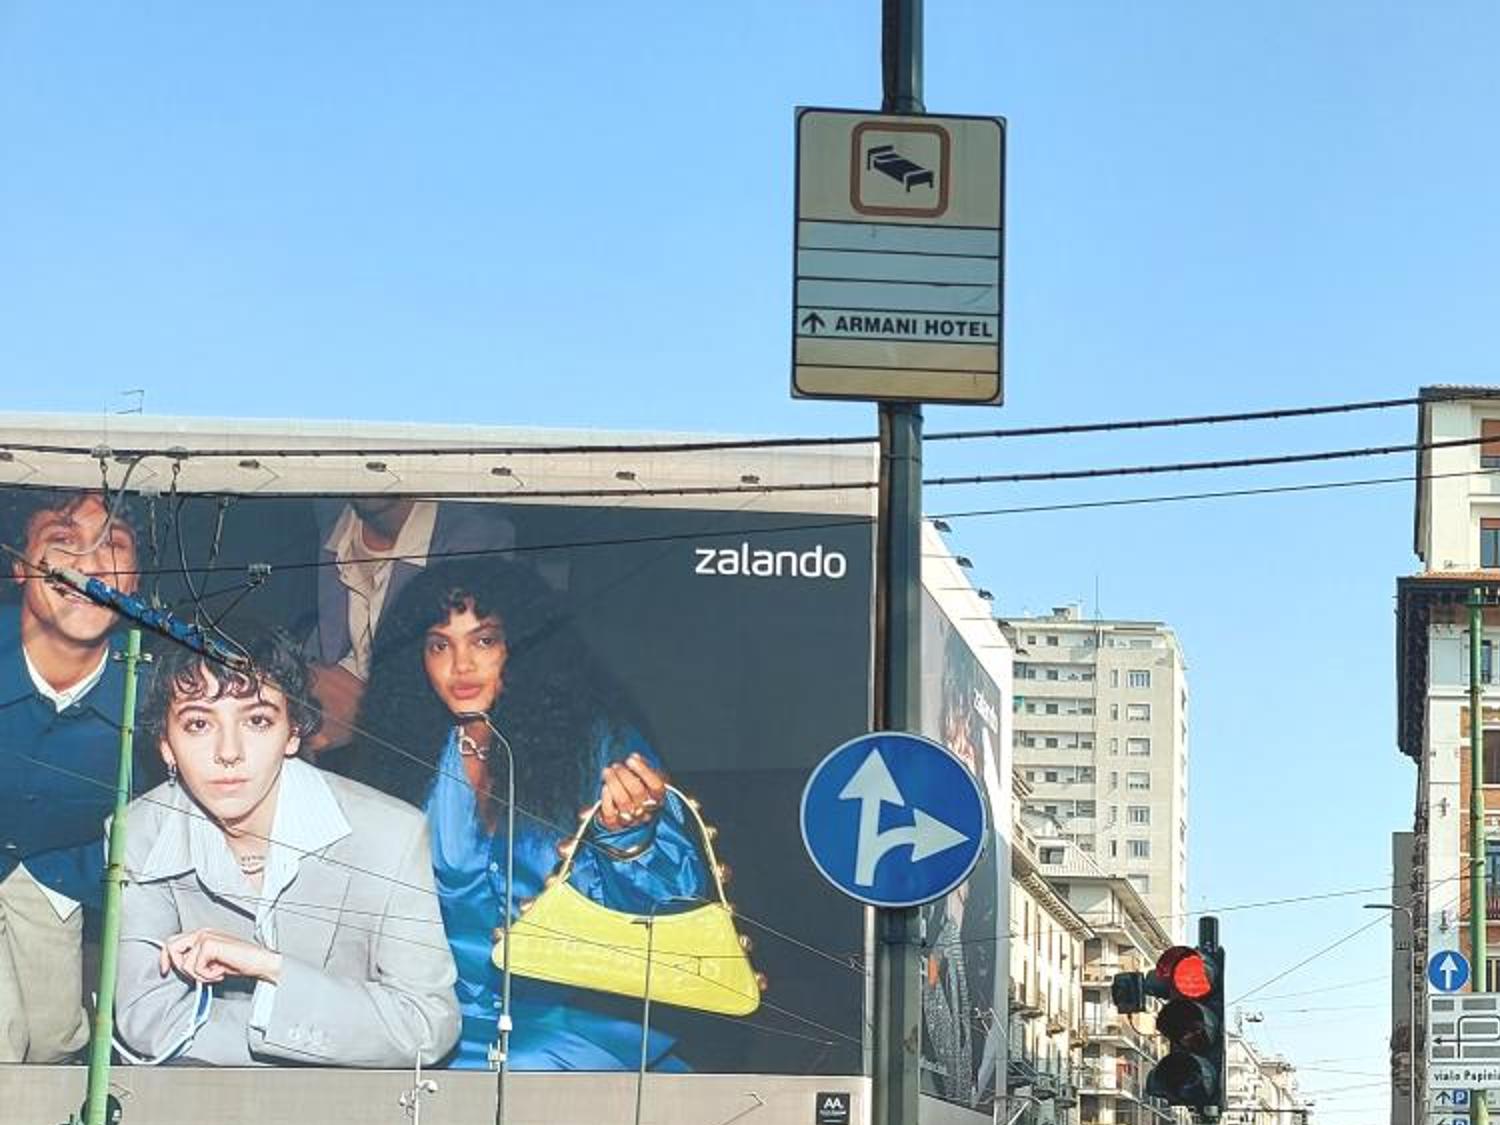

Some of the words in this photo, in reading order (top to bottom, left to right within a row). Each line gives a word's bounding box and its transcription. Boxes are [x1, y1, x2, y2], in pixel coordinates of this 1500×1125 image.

[835, 316, 917, 335] ARMANI
[925, 319, 993, 338] HOTEL
[694, 541, 848, 579] zalando
